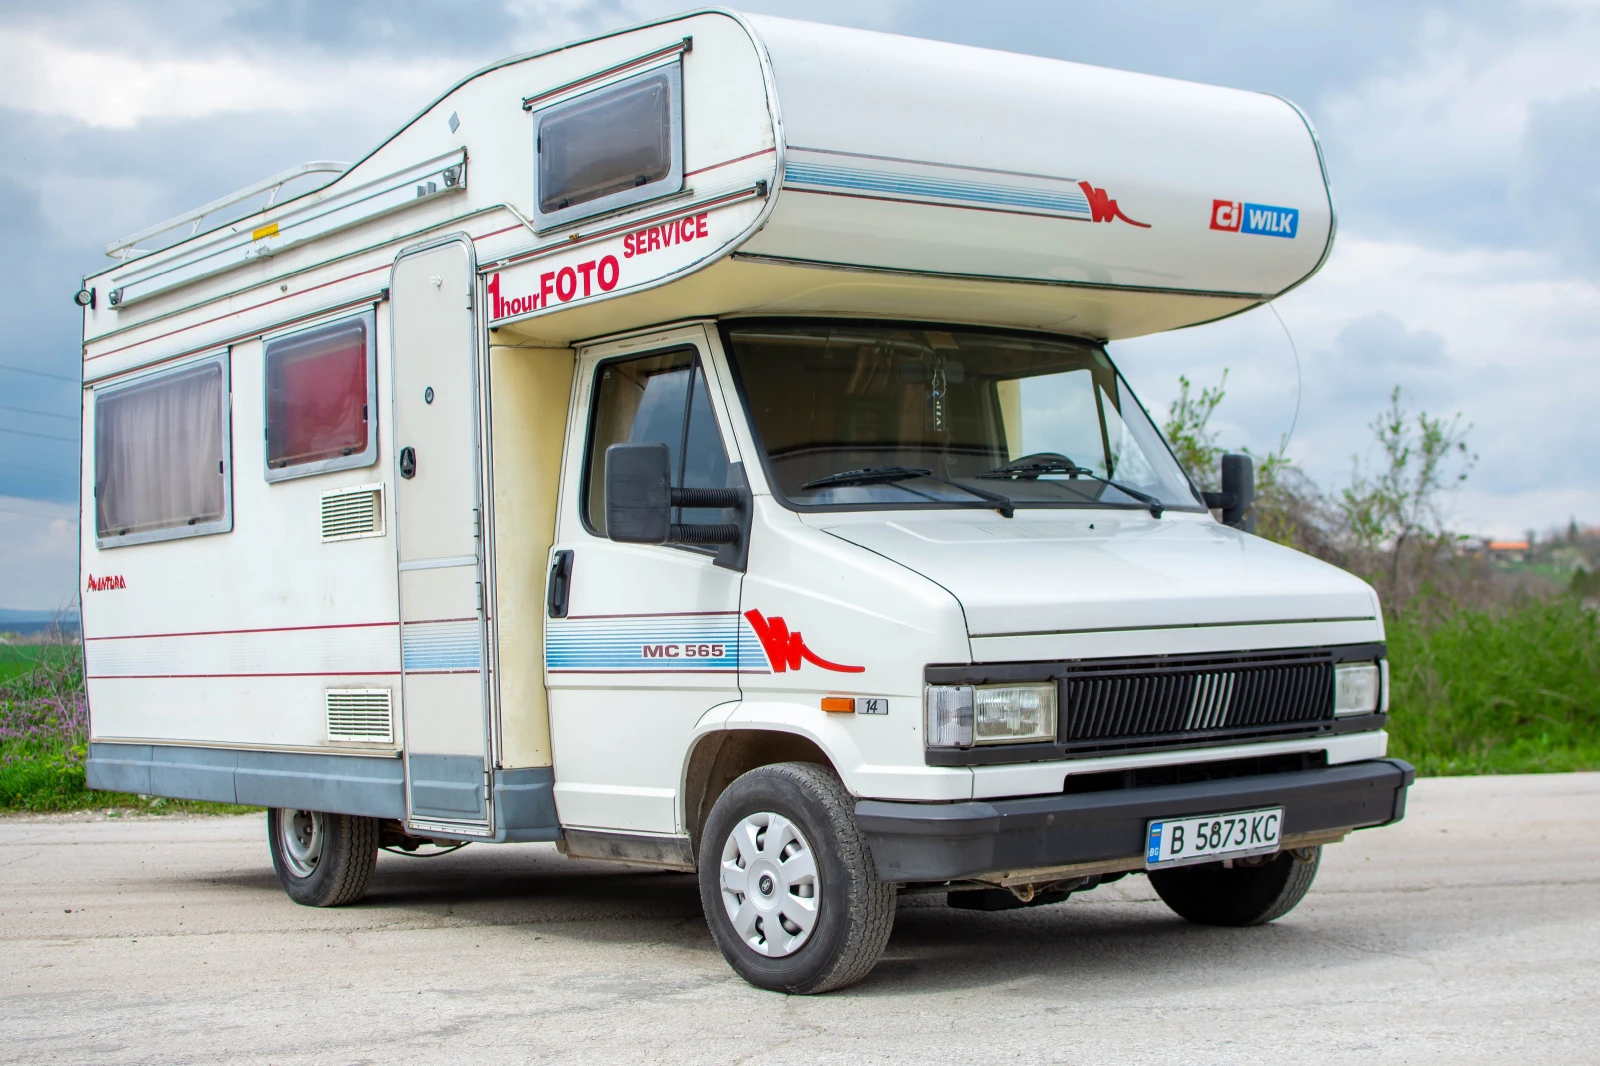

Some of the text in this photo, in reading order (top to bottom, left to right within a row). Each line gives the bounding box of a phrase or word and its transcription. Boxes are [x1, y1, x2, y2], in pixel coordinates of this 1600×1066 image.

[1249, 208, 1294, 234] WILK
[623, 212, 709, 259] SERVICE
[643, 644, 724, 658] MC 565
[866, 699, 878, 714] 14
[1170, 825, 1185, 855] B
[1149, 847, 1160, 857] BG
